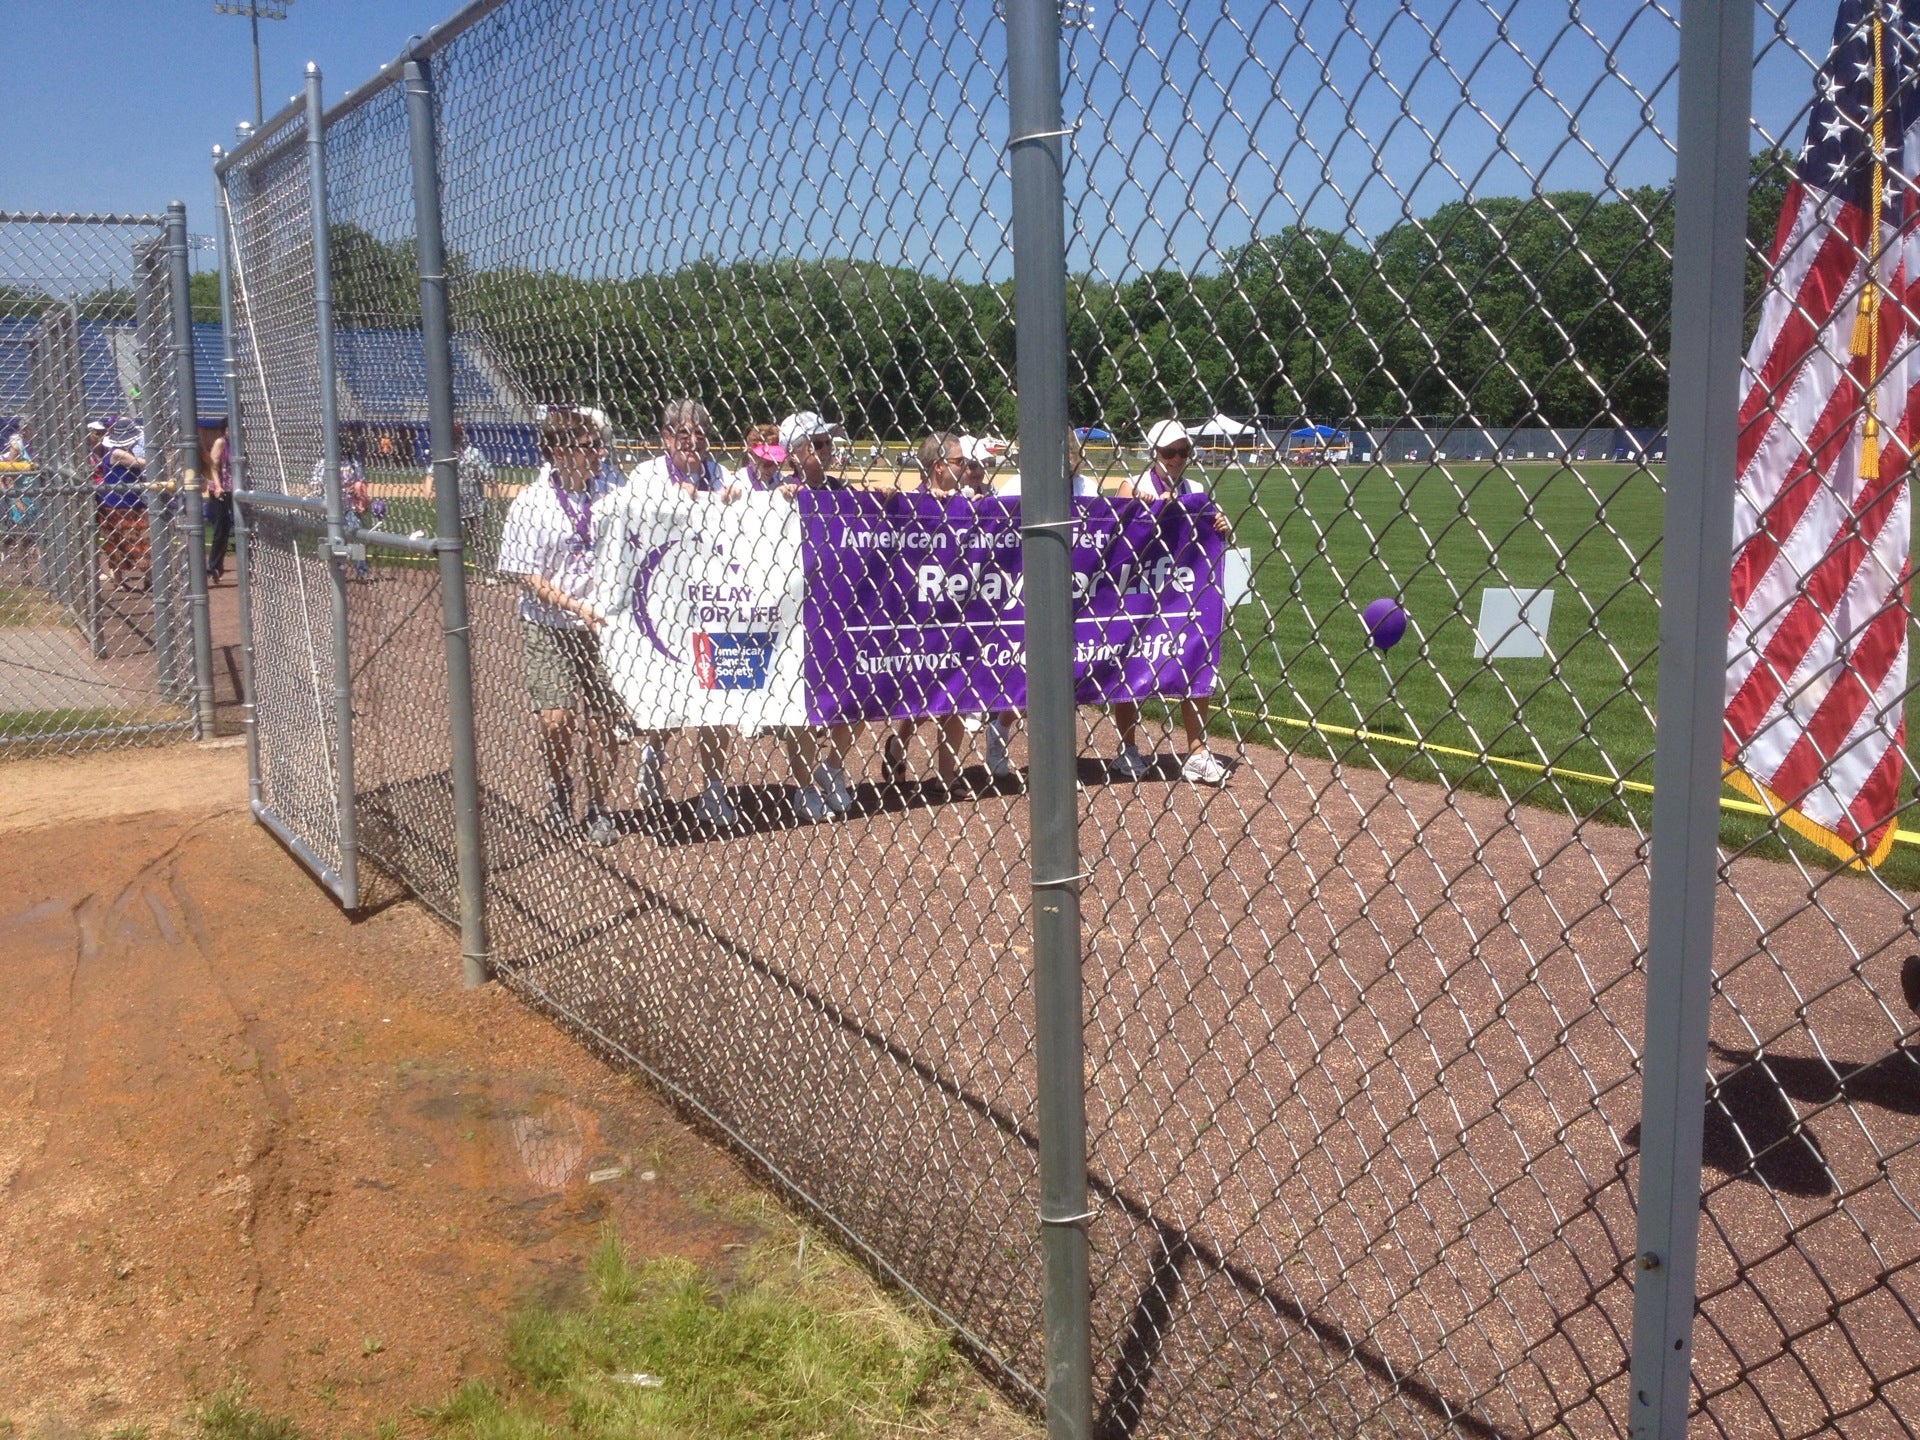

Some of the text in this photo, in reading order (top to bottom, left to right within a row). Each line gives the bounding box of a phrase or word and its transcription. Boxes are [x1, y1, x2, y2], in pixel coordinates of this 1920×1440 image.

[840, 526, 947, 549] American
[688, 585, 752, 602] RELAY
[918, 562, 1024, 611] Relay
[1118, 556, 1196, 595] Life
[855, 647, 961, 675] Survivors
[1126, 632, 1188, 664] Life!
